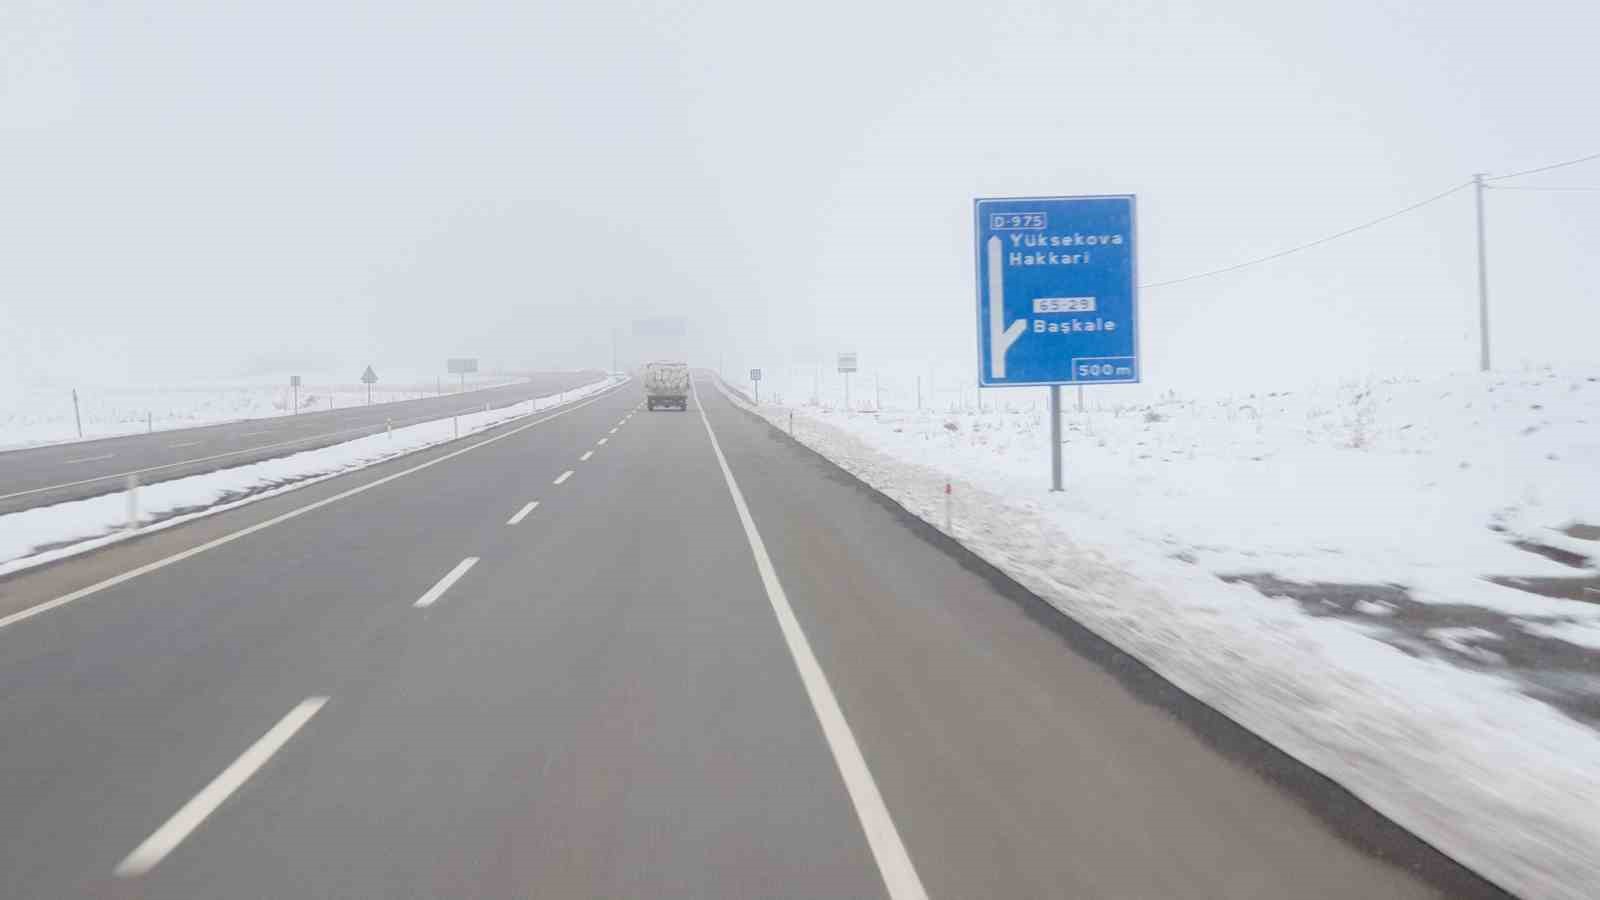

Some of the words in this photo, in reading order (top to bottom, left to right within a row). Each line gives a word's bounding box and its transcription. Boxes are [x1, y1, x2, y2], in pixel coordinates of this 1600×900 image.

[993, 215, 1042, 227] D-975
[1009, 252, 1090, 266] Hakkari
[1033, 318, 1116, 333] Başkale
